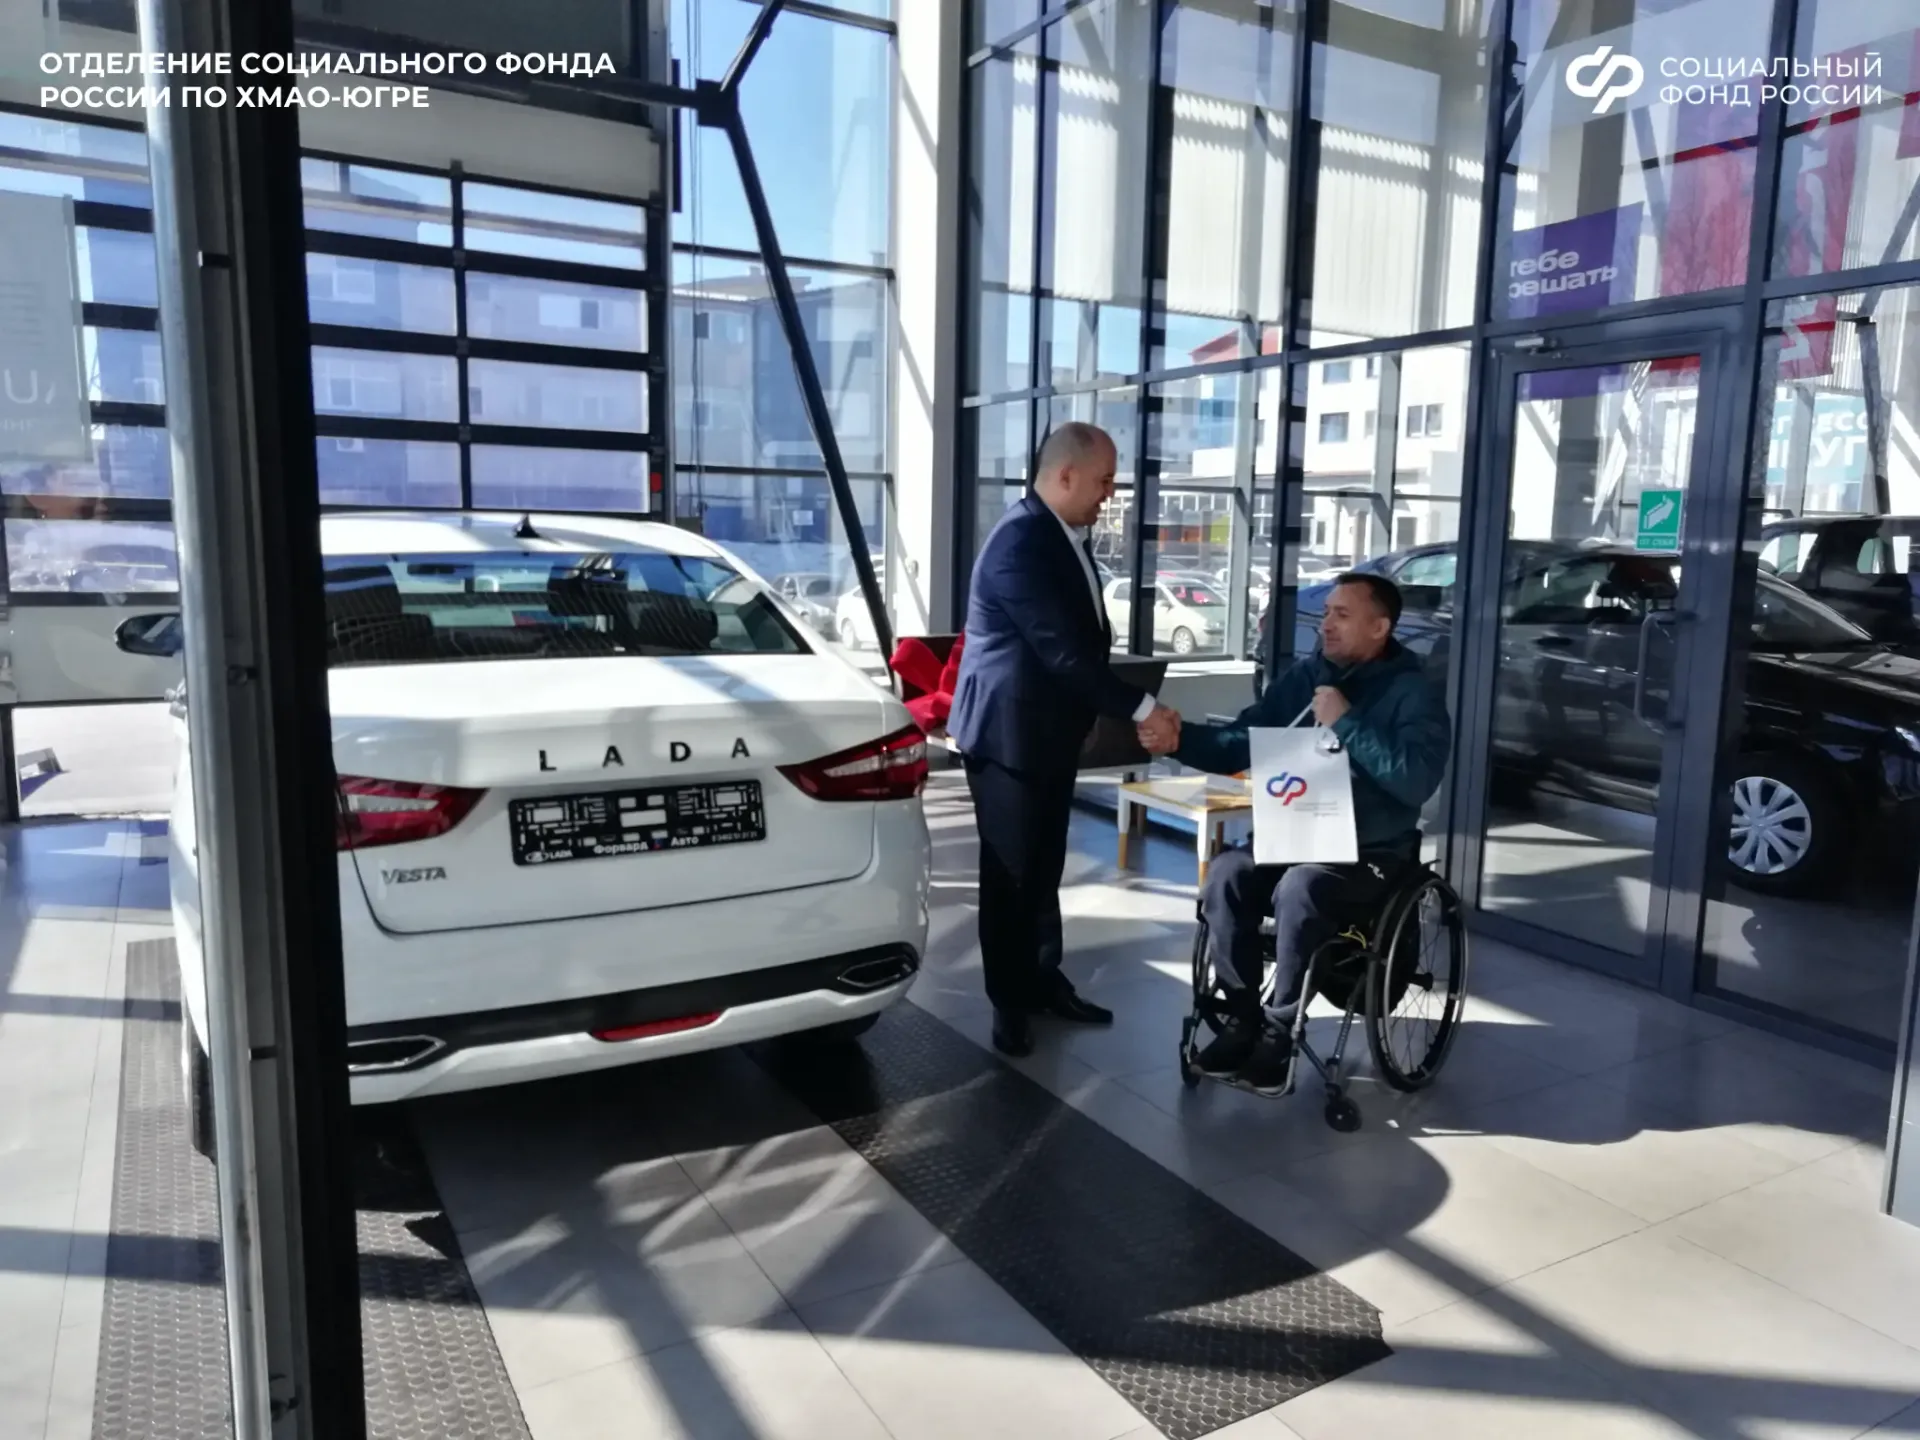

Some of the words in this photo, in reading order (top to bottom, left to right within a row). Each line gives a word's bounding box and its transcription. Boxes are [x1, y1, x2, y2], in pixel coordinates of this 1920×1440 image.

[538, 737, 751, 773] LADA
[592, 841, 649, 856] Форвард
[670, 835, 700, 847] Авто
